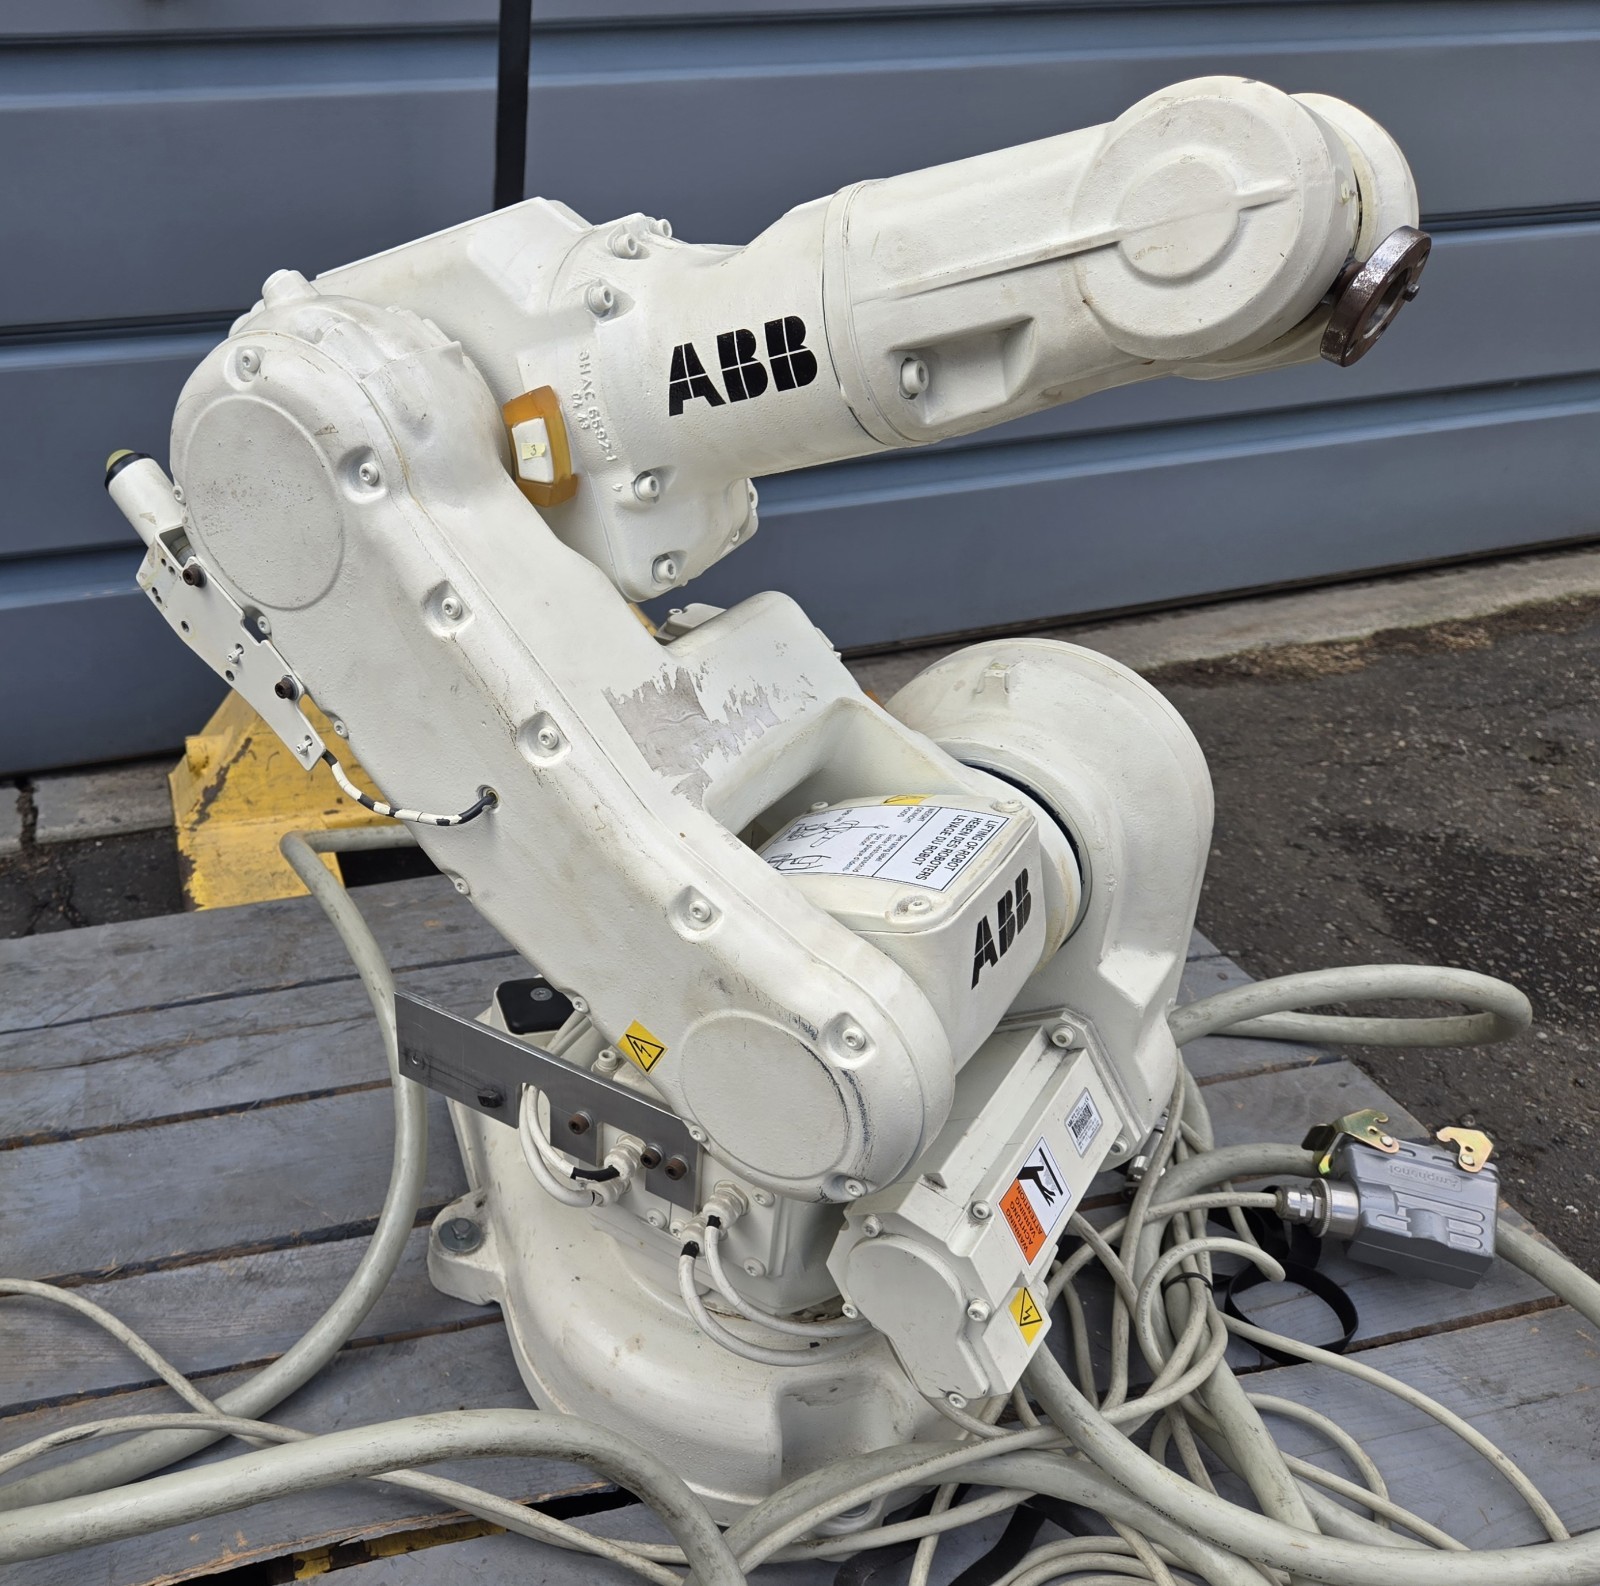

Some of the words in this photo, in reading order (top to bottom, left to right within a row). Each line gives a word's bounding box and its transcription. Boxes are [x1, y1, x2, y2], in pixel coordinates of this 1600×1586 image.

[669, 315, 818, 417] ABB
[530, 444, 537, 456] 3
[940, 815, 967, 836] LEVAGE
[958, 817, 983, 836] HEBEN
[971, 820, 998, 841] LIFTING
[931, 836, 946, 845] DU
[946, 836, 965, 848] DES
[964, 841, 978, 850] OF
[912, 845, 938, 866] ROBOT
[915, 848, 953, 880] ROBOTERS
[944, 850, 970, 871] ROBOT
[971, 868, 1032, 991] ABB
[1015, 1197, 1036, 1238] VARNING
[1016, 1186, 1043, 1234] ATTENTION
[1006, 1208, 1028, 1253] WARNING
[1010, 1201, 1033, 1245] ACHTUNG
